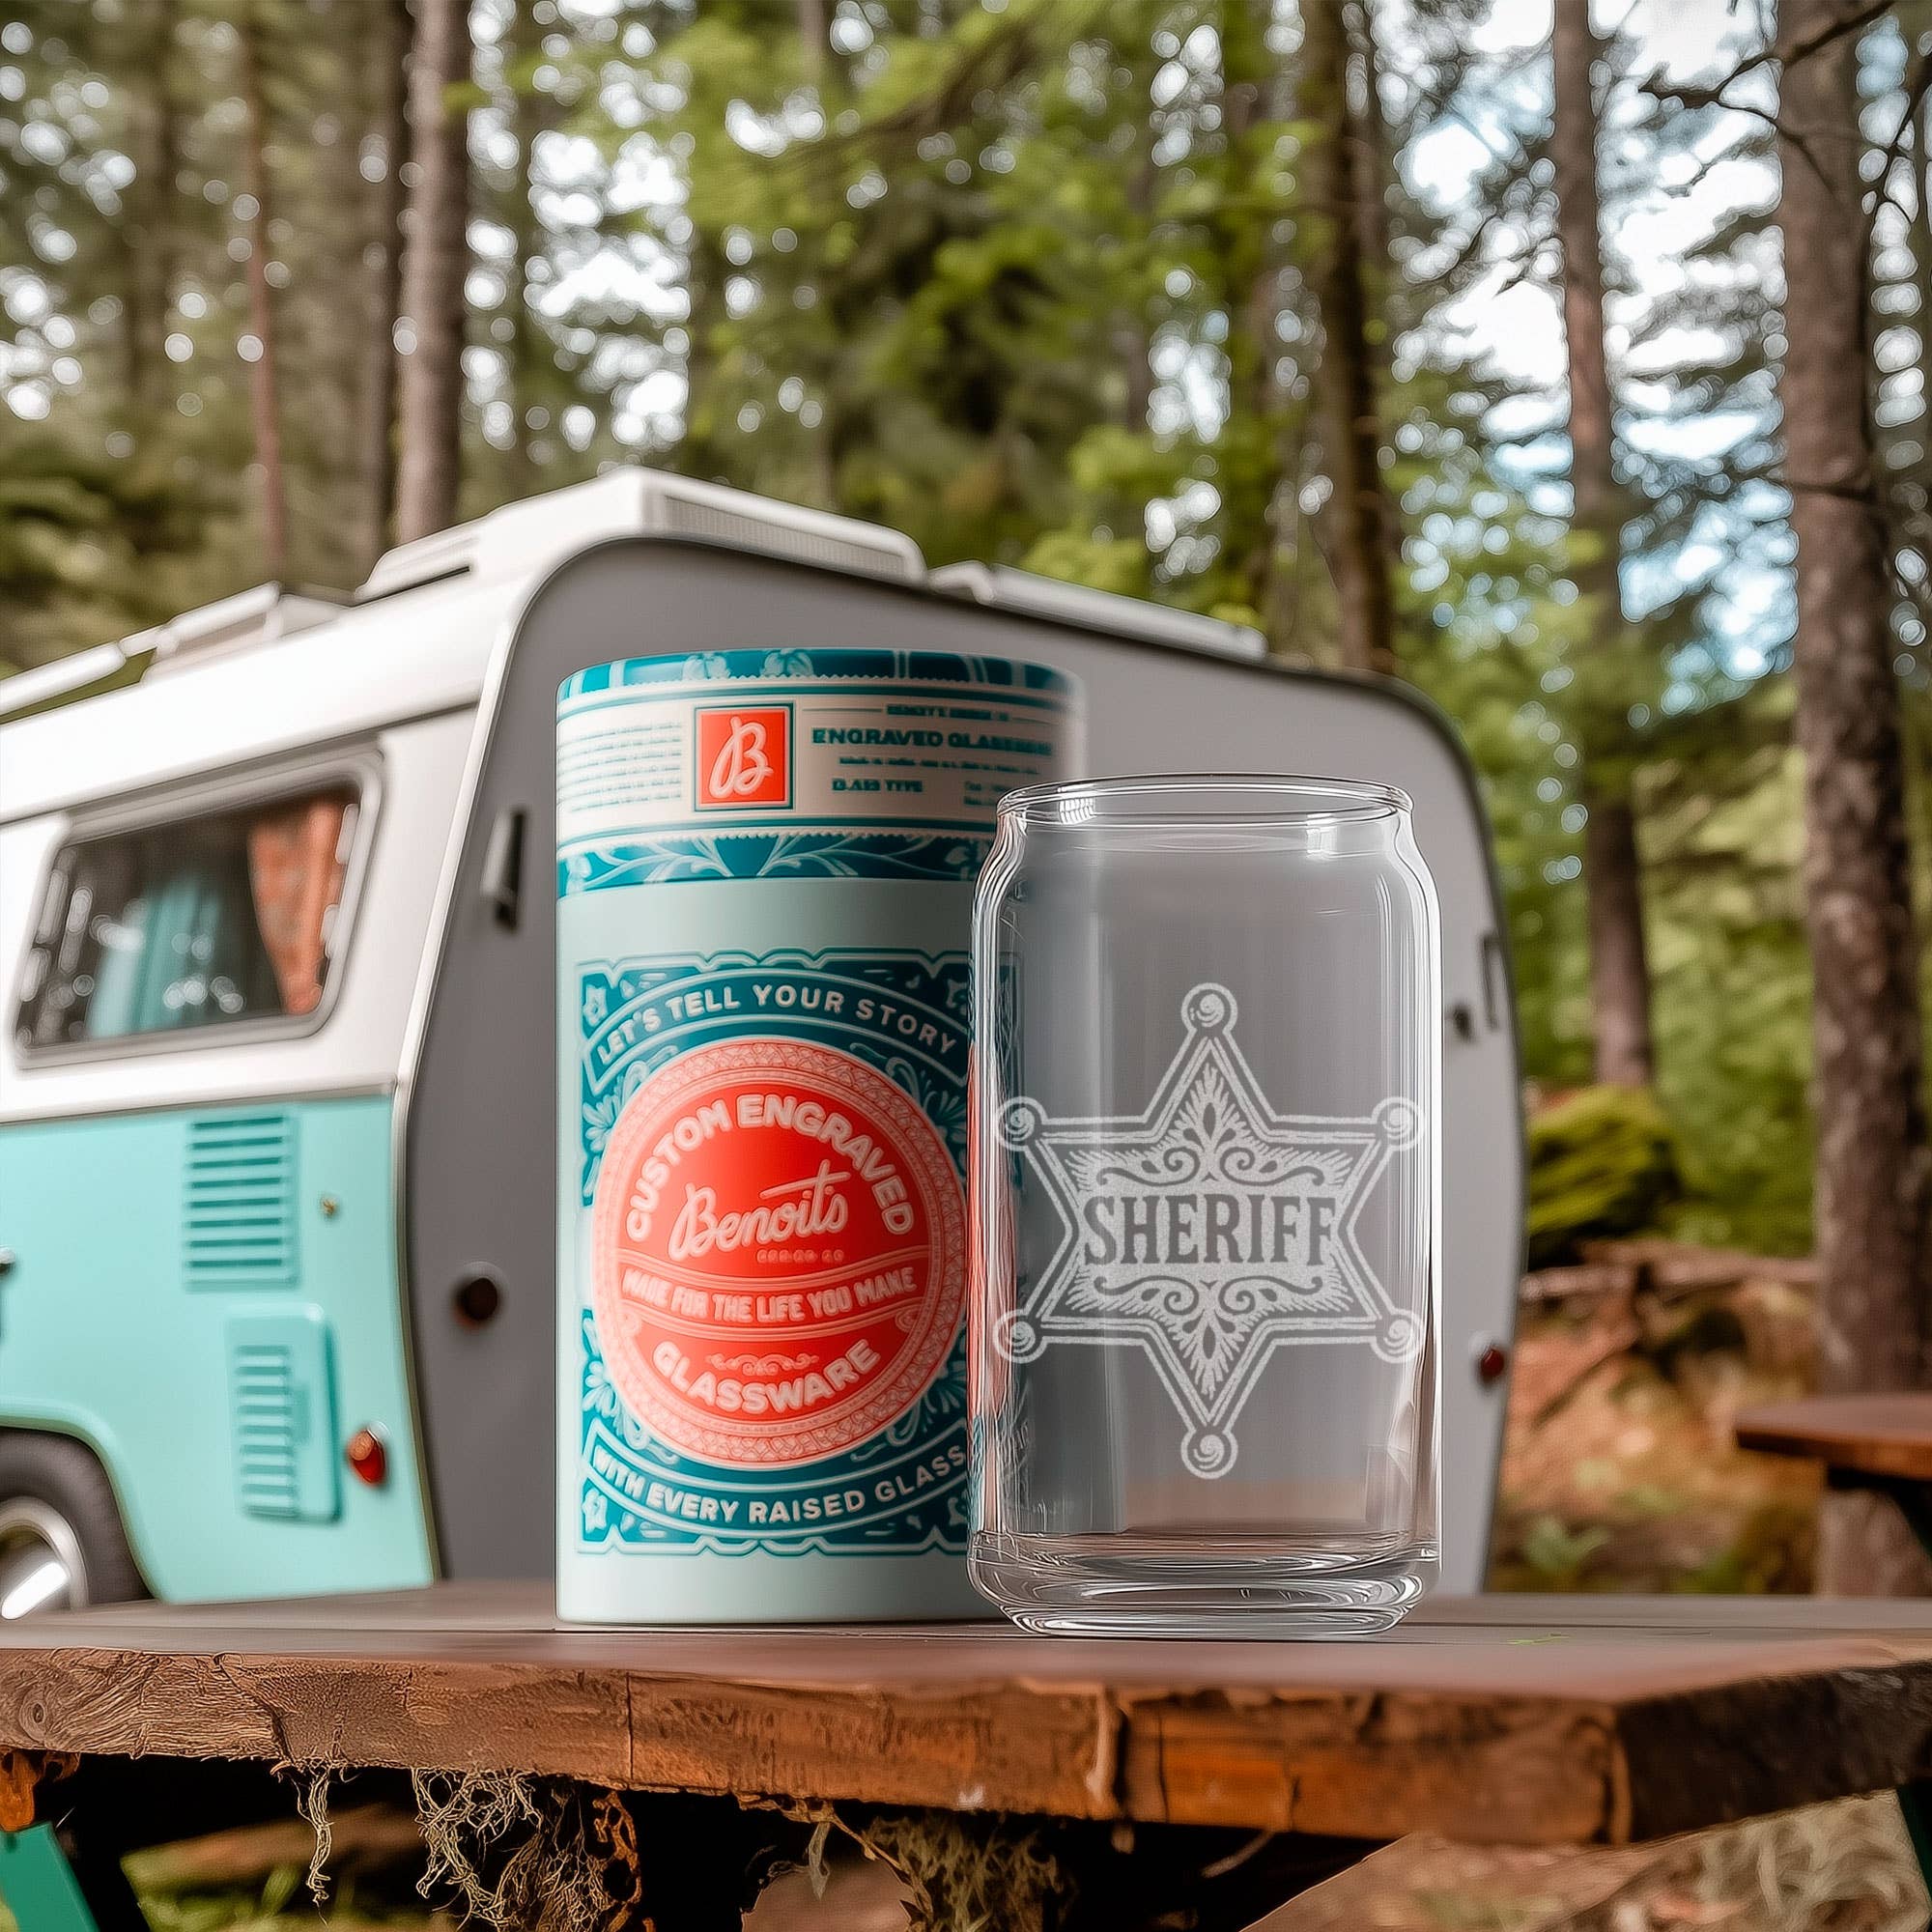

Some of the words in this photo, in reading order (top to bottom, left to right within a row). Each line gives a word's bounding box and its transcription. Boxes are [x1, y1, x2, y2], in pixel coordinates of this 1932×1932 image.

[811, 727, 944, 748] ENGRAVED
[597, 1008, 662, 1065] LET'S
[665, 986, 741, 1021] TELL
[753, 983, 845, 1013] YOUR
[855, 999, 957, 1056] STORY
[626, 1099, 732, 1242] CUSTOM
[736, 1094, 914, 1235] ENGRAVED
[1083, 1194, 1336, 1265] SHERIFF
[711, 1293, 753, 1322] THE
[756, 1293, 806, 1322] LIFE
[807, 1285, 853, 1318] YOU
[651, 1338, 882, 1413] GLASSWARE
[593, 1449, 644, 1499] WITH
[645, 1482, 740, 1523] EVERY
[749, 1490, 866, 1523] RAISED
[874, 1445, 966, 1502] GLASS
